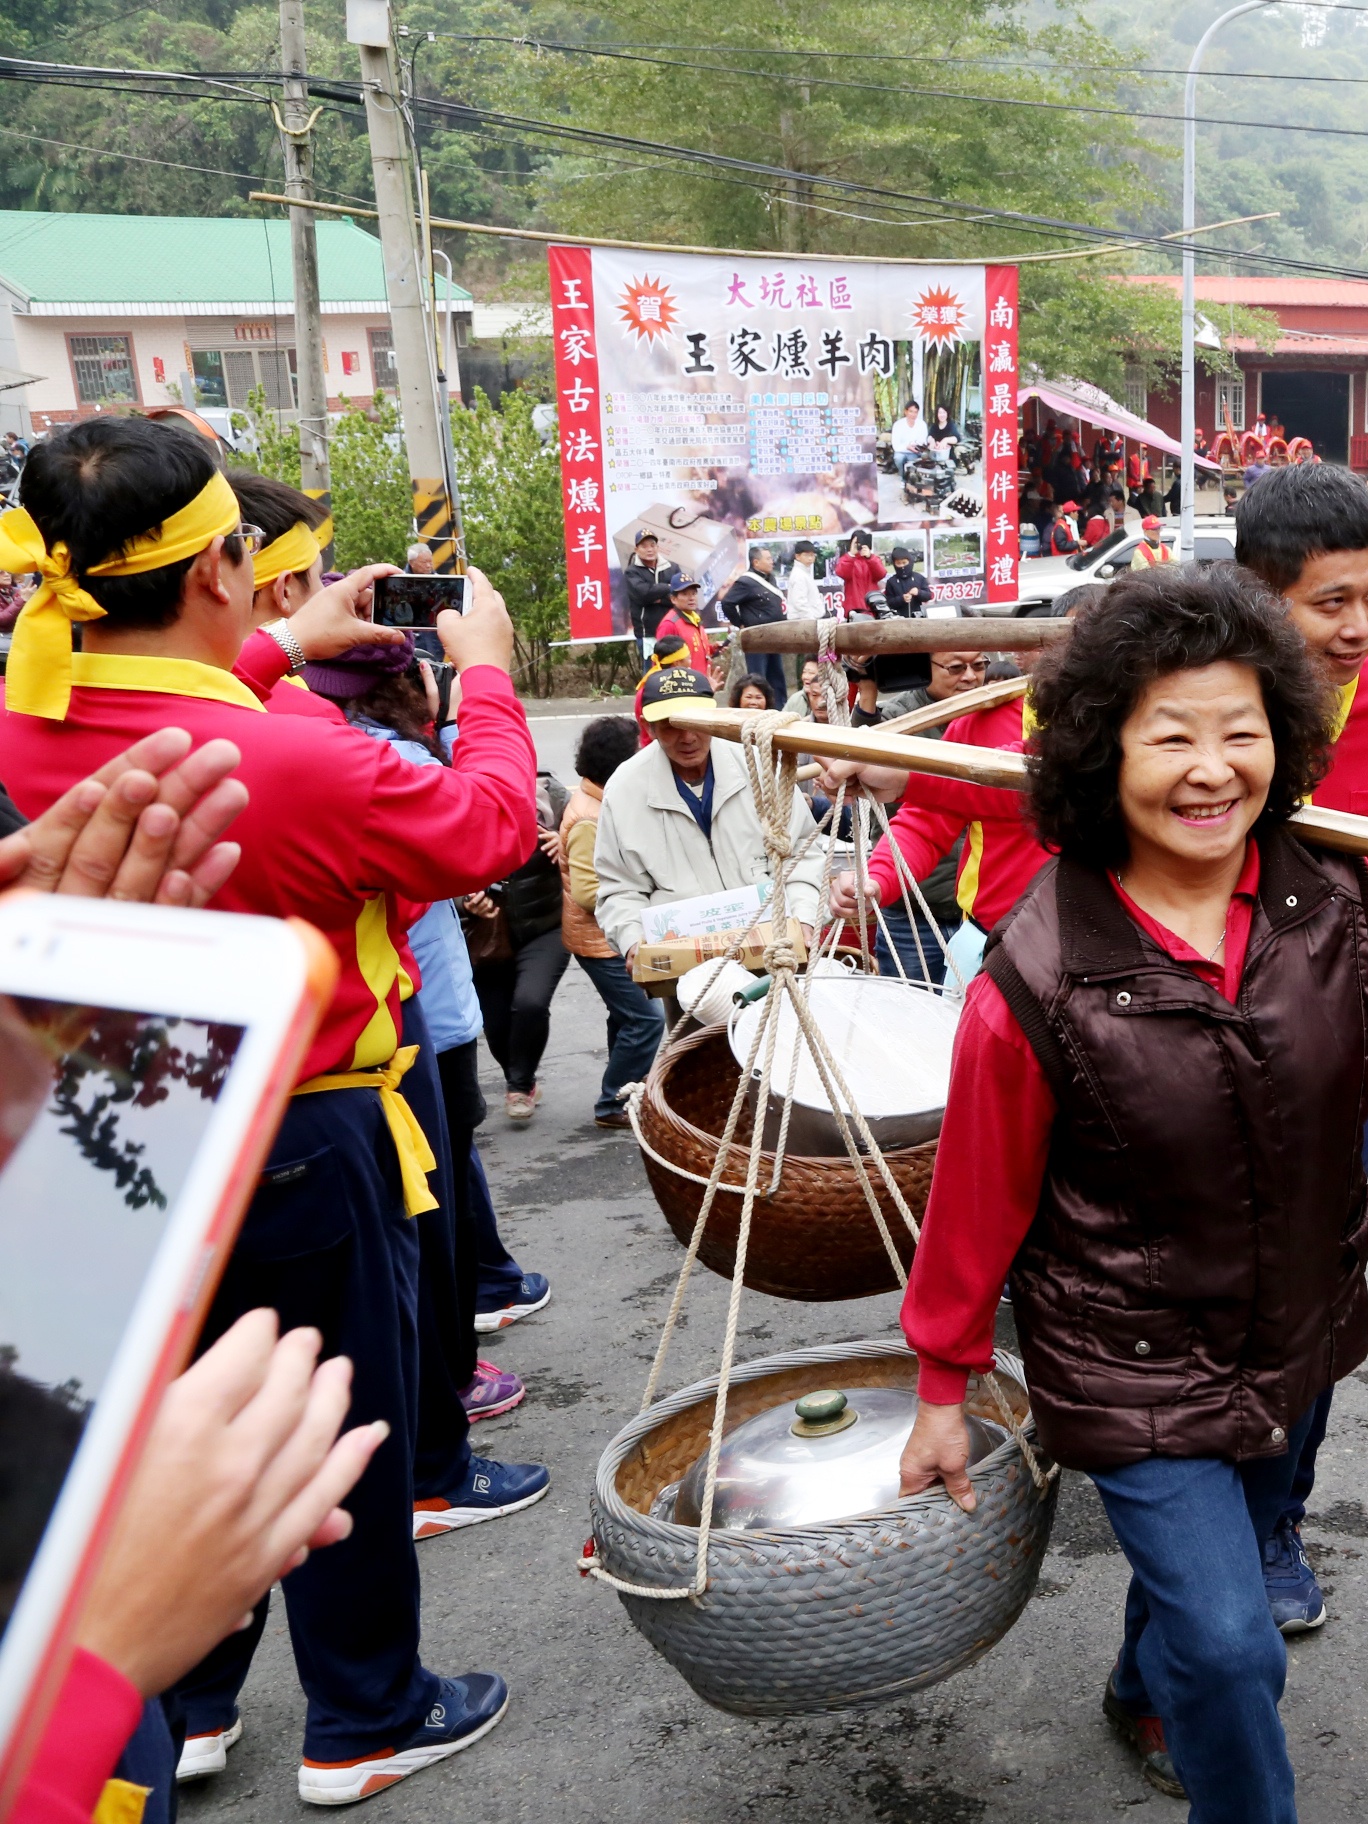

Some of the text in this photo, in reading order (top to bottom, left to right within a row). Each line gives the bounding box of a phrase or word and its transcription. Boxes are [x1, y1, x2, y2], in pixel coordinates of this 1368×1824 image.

[636, 295, 663, 323] 賀
[725, 272, 855, 311] 大坑社區
[920, 305, 958, 327] 榮獲
[683, 329, 894, 379] 王家燻羊肉
[556, 277, 604, 612] 王家古法燻羊肉
[988, 296, 1016, 588] 南瀛最佳伴手禮
[747, 515, 823, 533] 本農場景點
